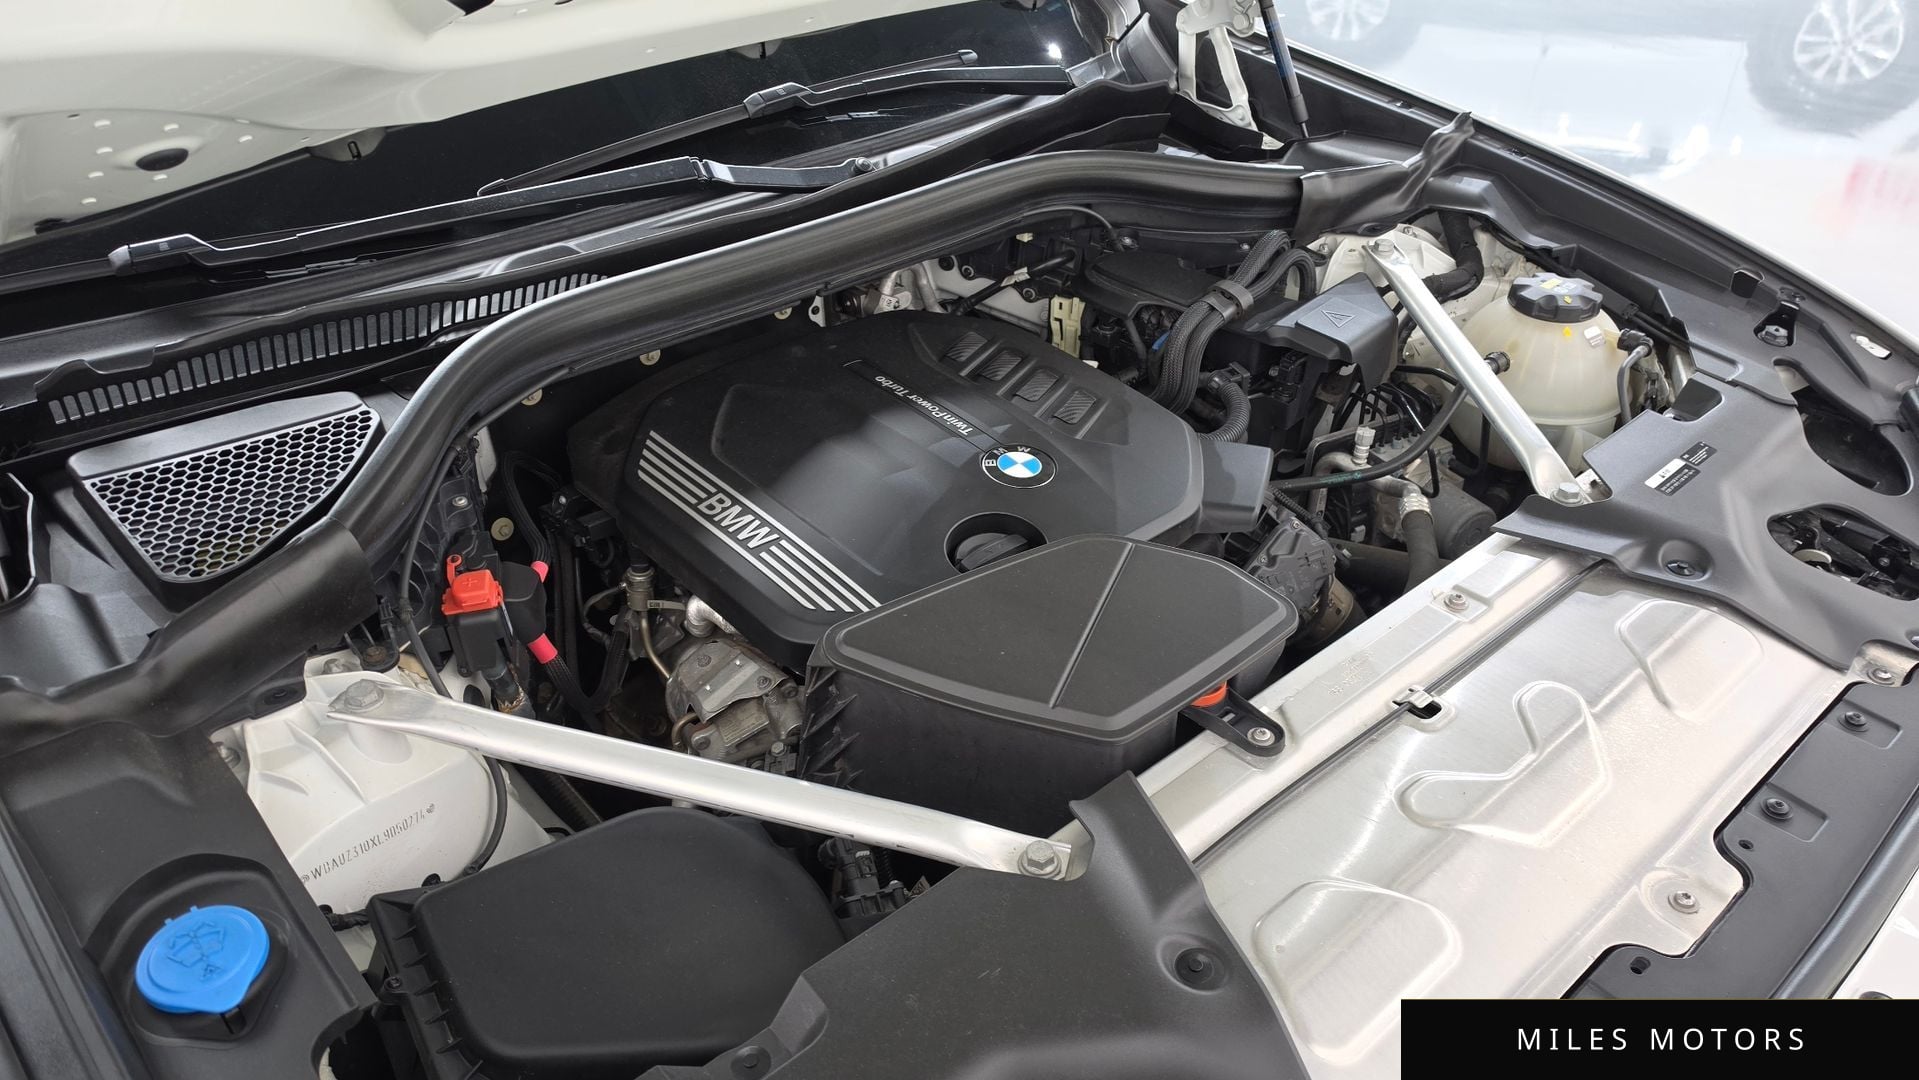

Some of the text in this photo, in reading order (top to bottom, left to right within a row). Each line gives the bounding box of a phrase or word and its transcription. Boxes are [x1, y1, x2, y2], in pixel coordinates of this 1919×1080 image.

[875, 375, 974, 436] TwinPower Turbo
[985, 446, 1031, 467] BMW
[696, 492, 780, 549] BMW
